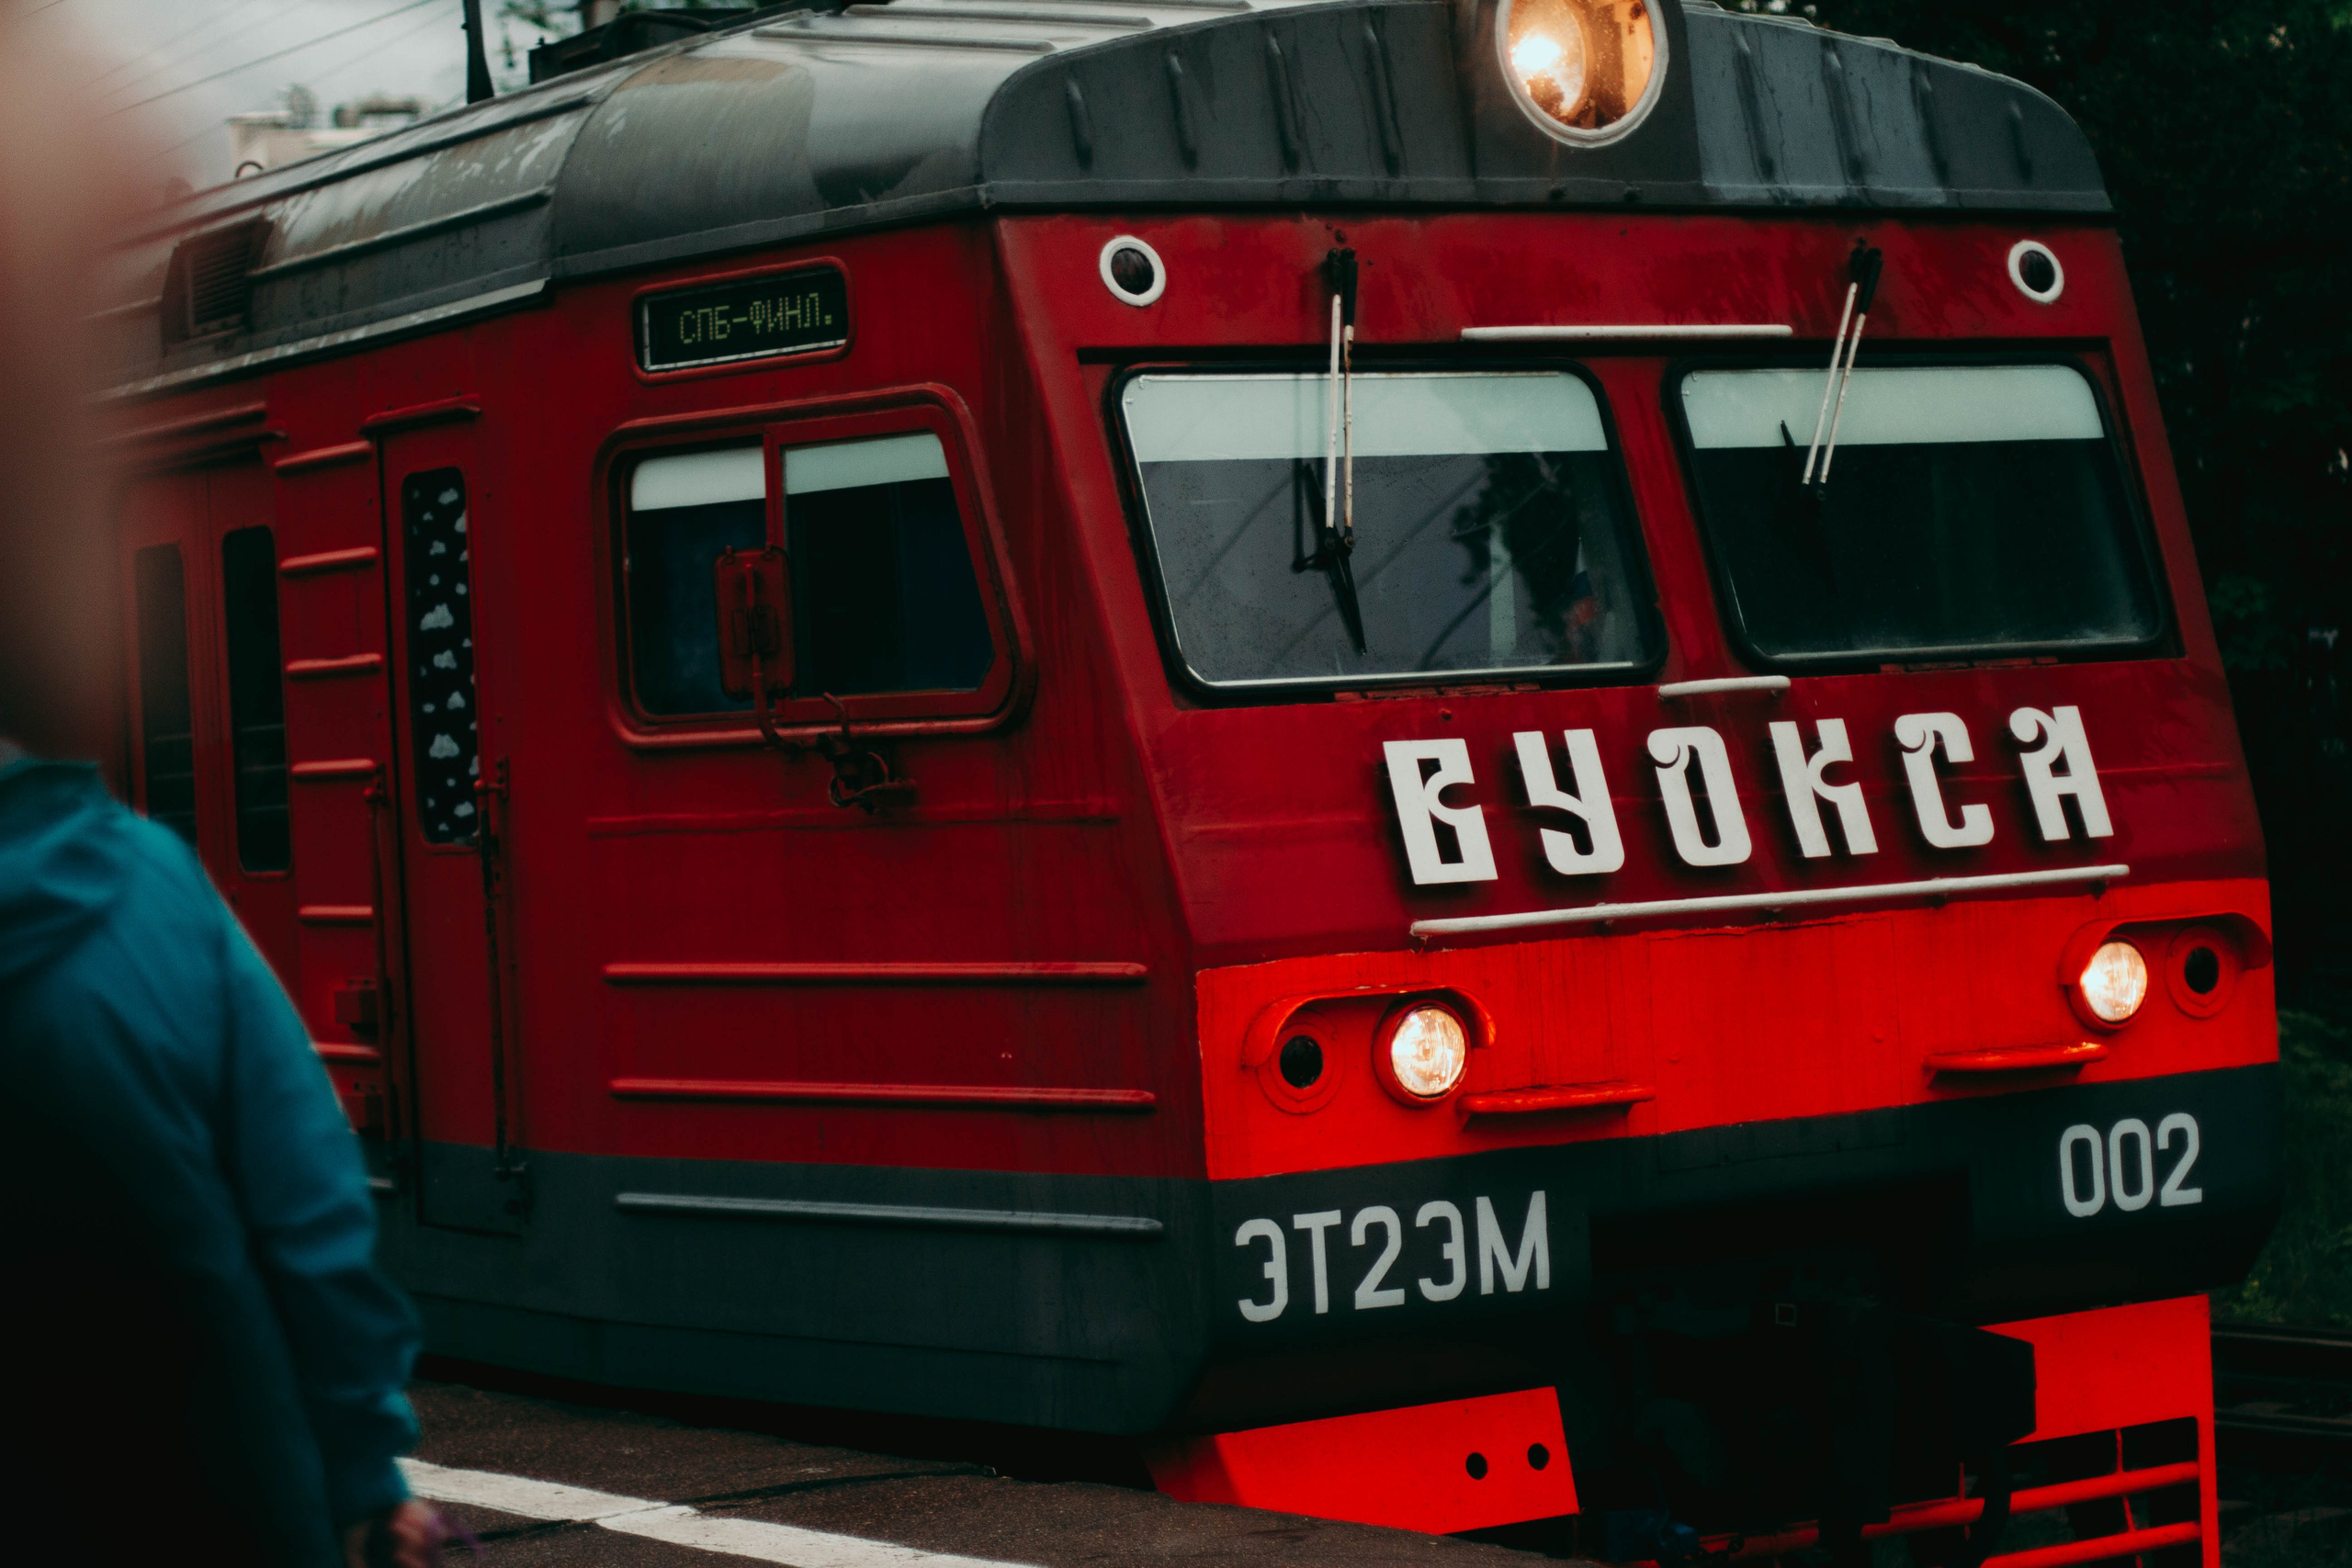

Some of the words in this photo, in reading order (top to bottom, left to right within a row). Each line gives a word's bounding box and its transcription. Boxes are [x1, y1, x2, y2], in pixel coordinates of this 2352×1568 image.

[679, 292, 833, 345] СПБ-ФИНЛ.
[1383, 705, 2114, 886] ВУОКСА
[2059, 1111, 2203, 1218] 002
[1235, 1190, 1550, 1323] ЭТ2ЭМ
